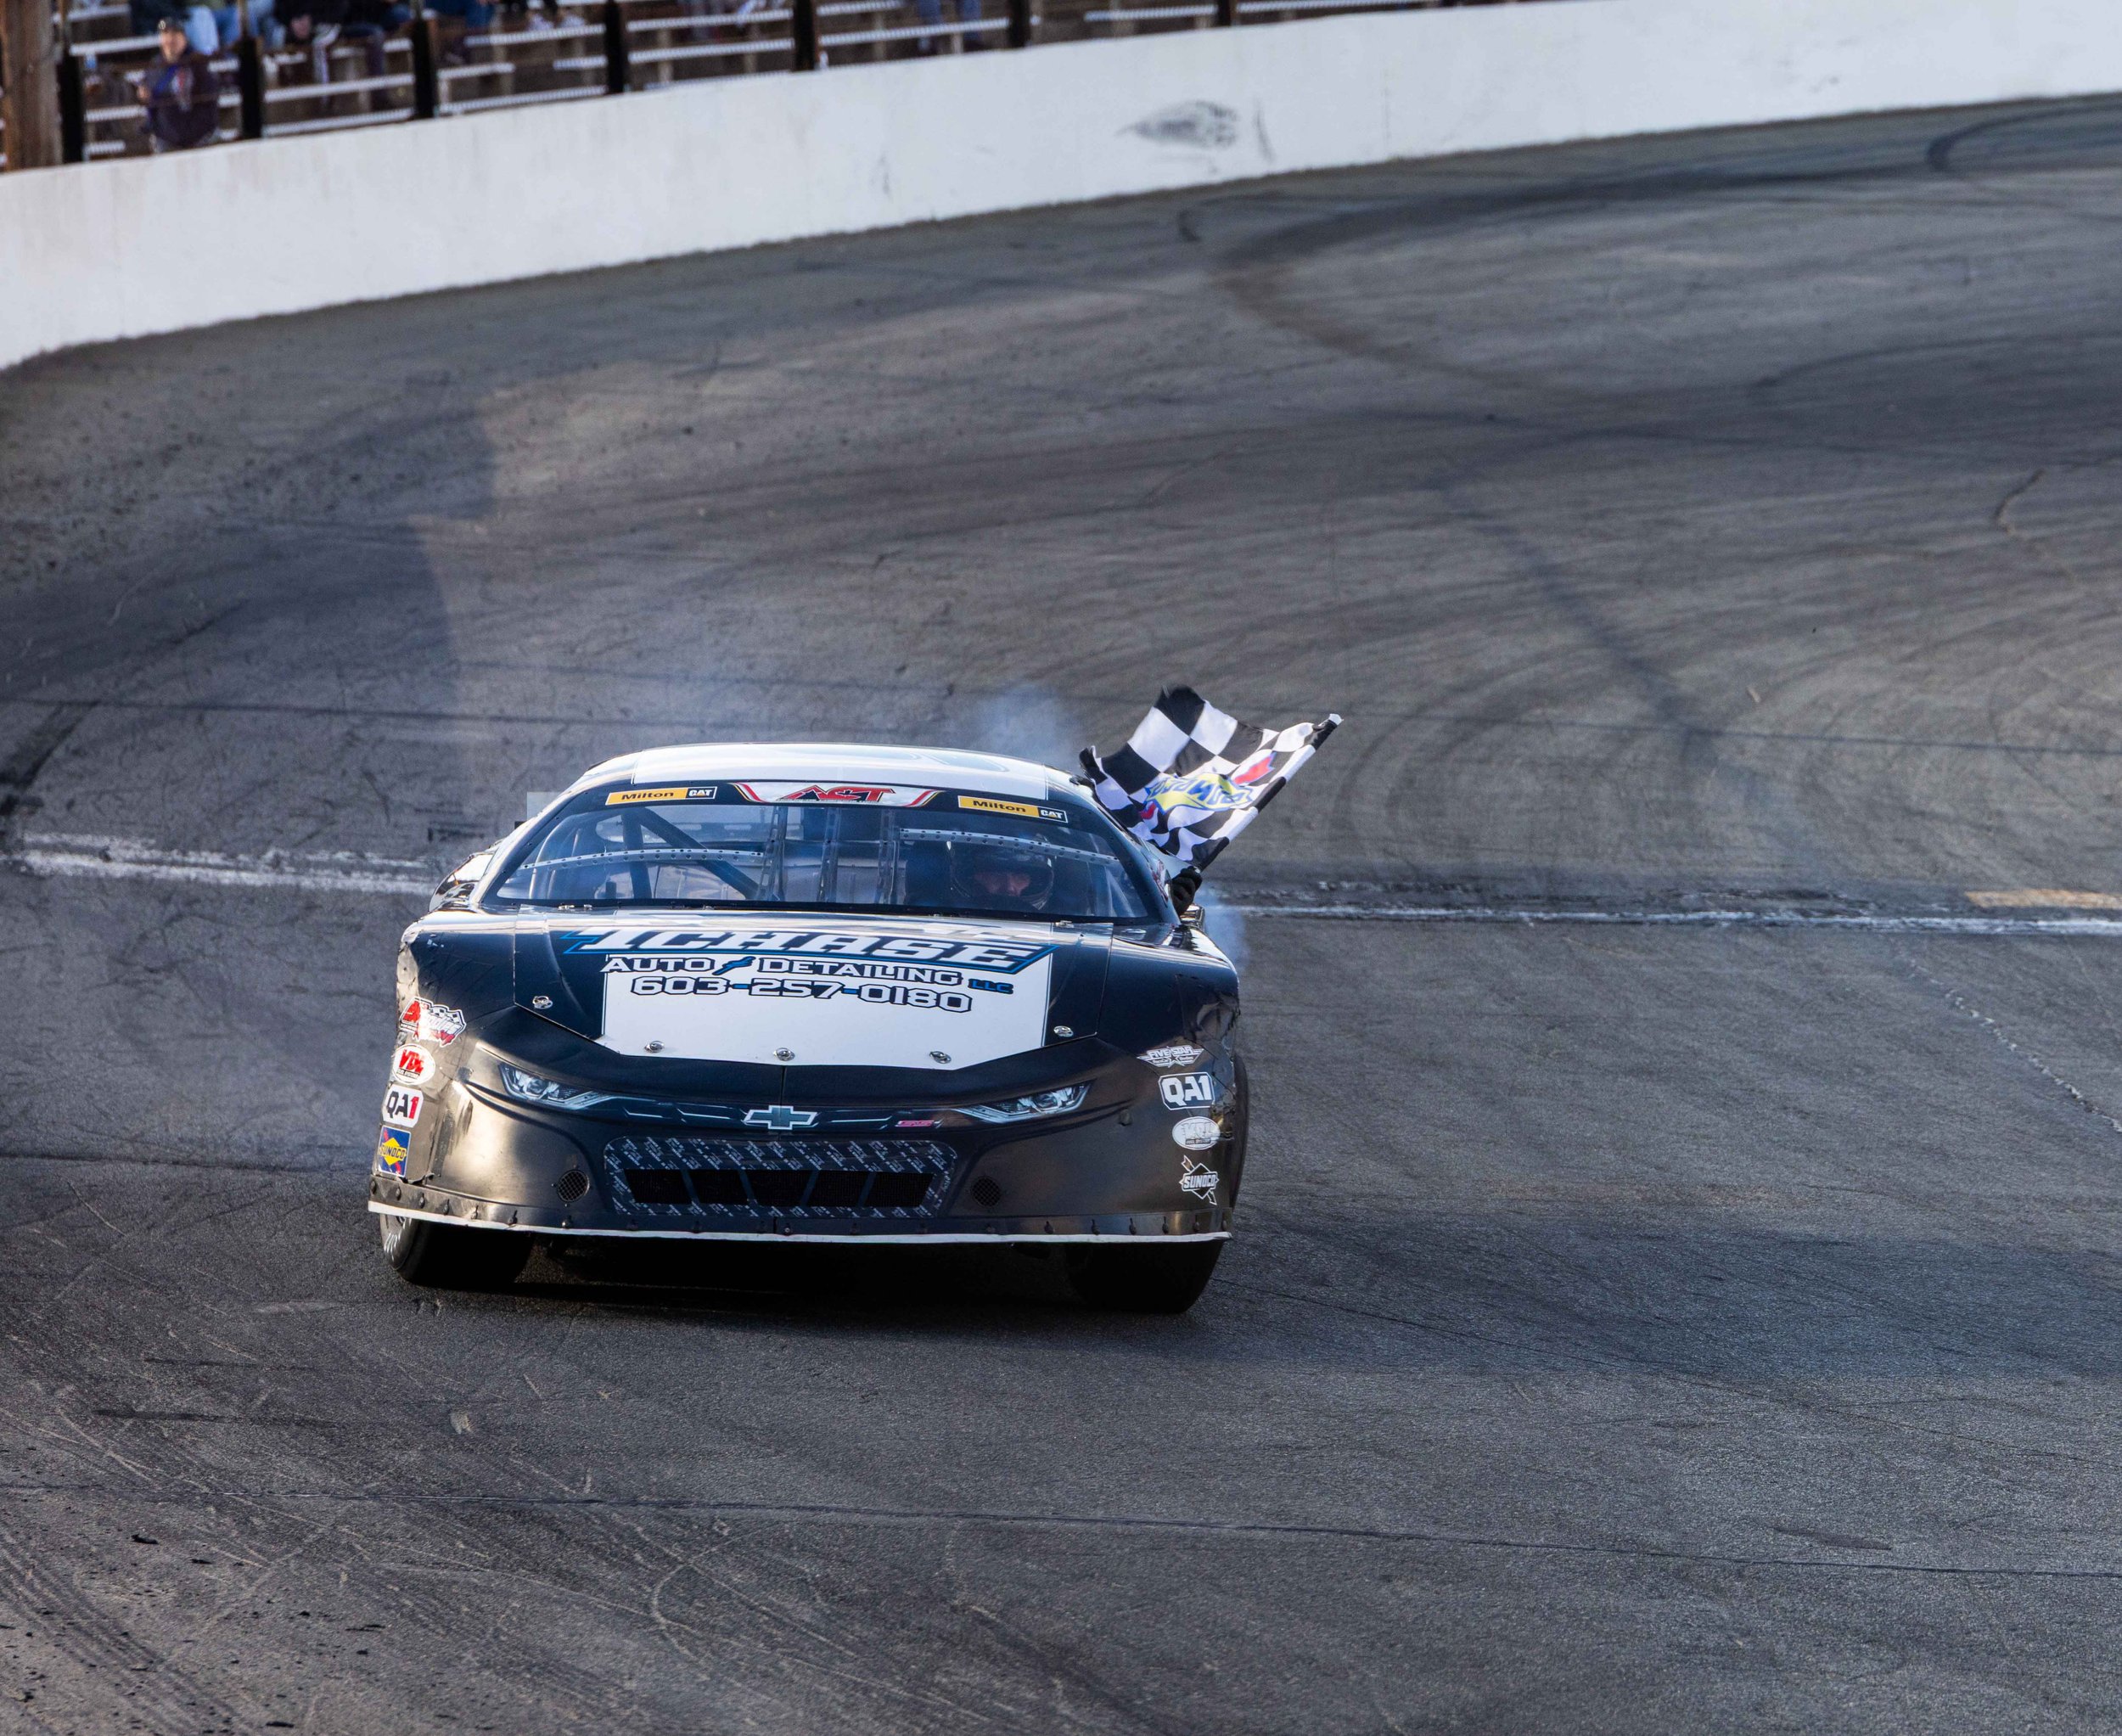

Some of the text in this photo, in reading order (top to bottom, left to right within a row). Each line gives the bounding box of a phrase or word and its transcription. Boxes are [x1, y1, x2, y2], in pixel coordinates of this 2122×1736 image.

[620, 789, 713, 801] Milton CAT
[775, 784, 896, 803] ACT
[973, 800, 1063, 819] Milton CAT
[599, 956, 1013, 995] AUTO DETAILING LLC
[631, 975, 973, 1014] 603-257-0180
[1148, 1045, 1193, 1059] FIVE STAR
[1161, 1075, 1212, 1106] QA1
[385, 1091, 419, 1120] QA1
[379, 1143, 407, 1160] SUNOCO
[1182, 1173, 1217, 1189] SUNOCO
